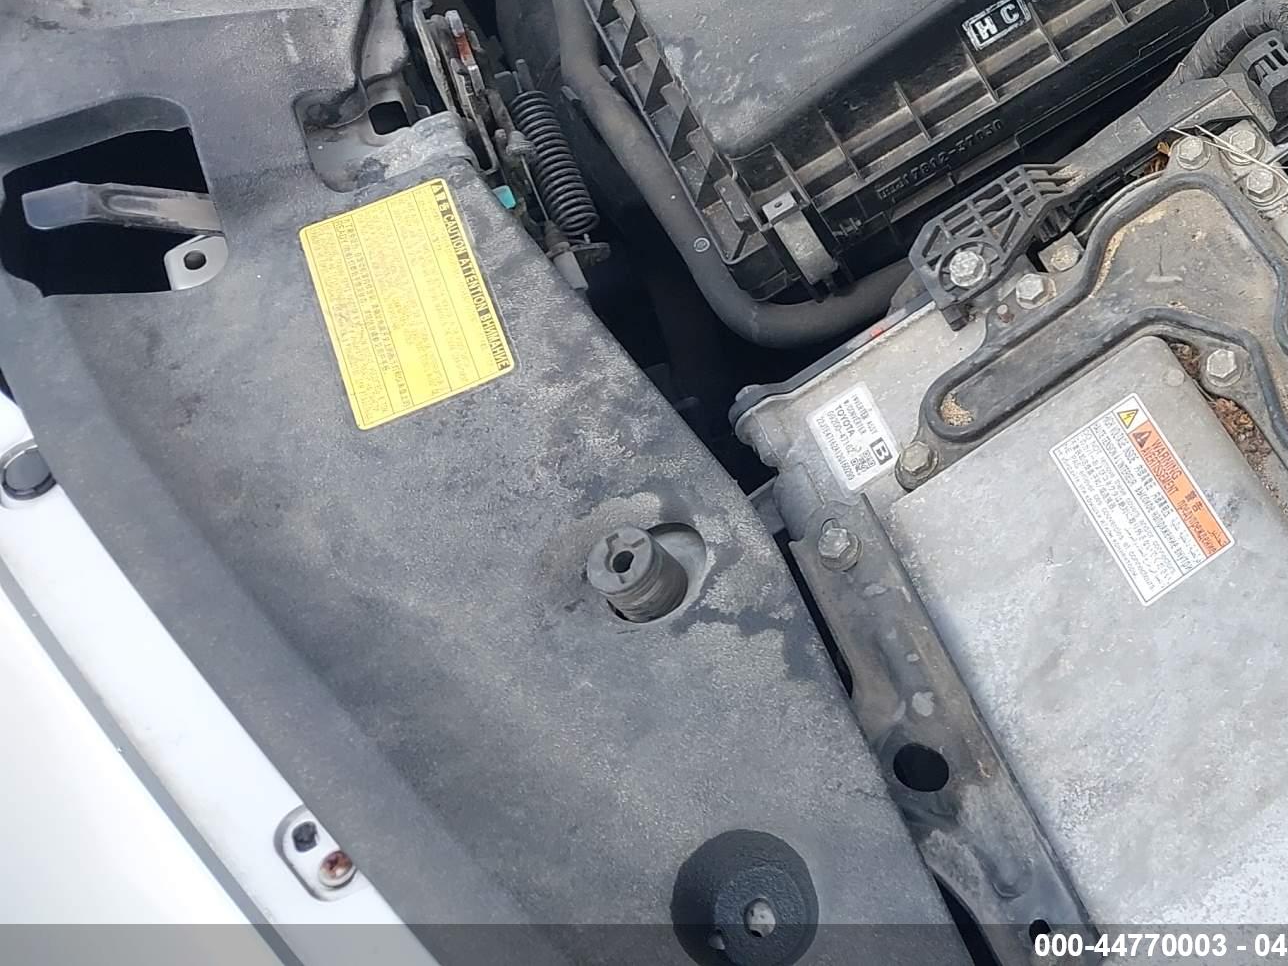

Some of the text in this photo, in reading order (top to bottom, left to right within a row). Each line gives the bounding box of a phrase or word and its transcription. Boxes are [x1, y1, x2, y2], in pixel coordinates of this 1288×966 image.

[441, 212, 467, 256] CAUTION
[456, 256, 488, 313] ATTENTION
[477, 313, 509, 370] ВНИМАНИЕ
[833, 403, 856, 437] TOYOTA
[872, 440, 890, 461] B
[1139, 445, 1179, 496] AVERTISSEMENT
[1149, 438, 1183, 480] WARNING
